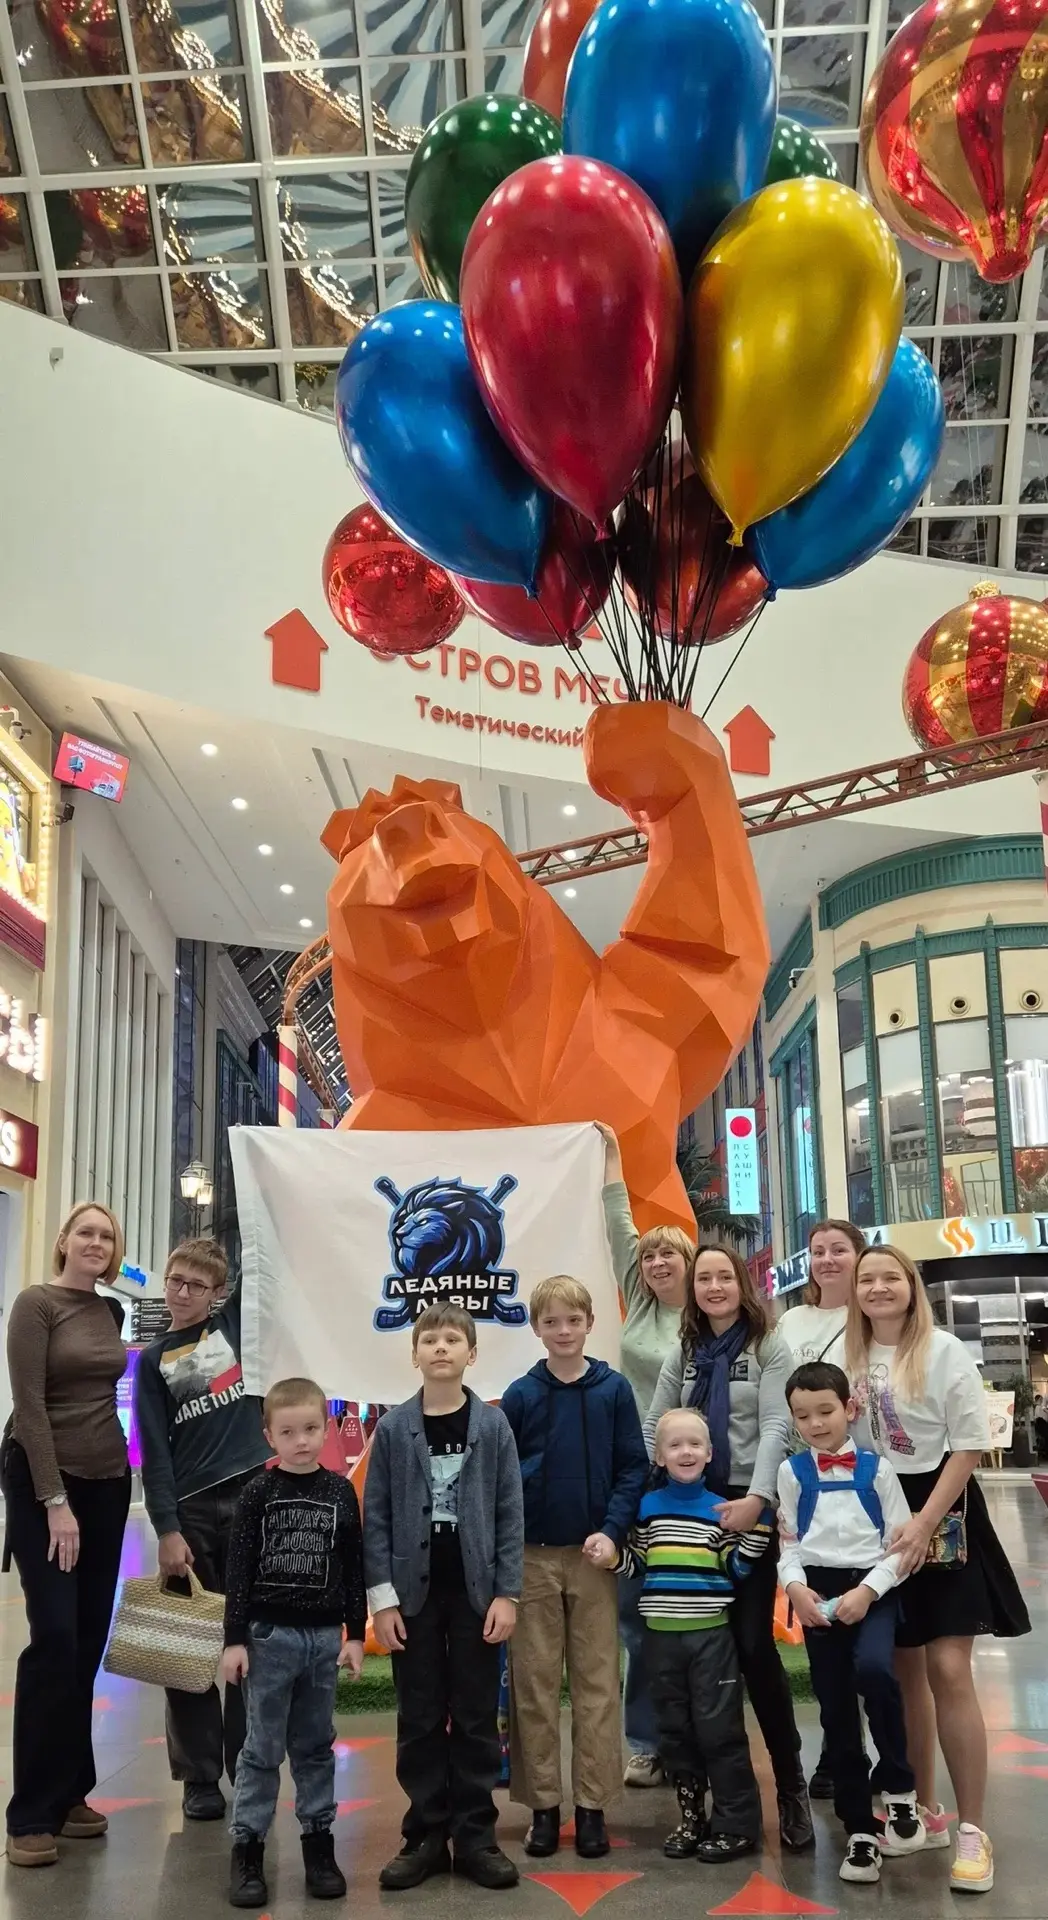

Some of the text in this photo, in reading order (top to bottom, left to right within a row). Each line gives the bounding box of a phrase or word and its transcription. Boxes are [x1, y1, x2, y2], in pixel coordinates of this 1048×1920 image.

[370, 643, 543, 695] СТРОВ
[415, 694, 583, 748] Тематический
[733, 1143, 743, 1207] ПЛАНЕТА
[742, 1143, 752, 1179] СУШИ
[389, 1275, 513, 1295] ЛЕДЯНЫЕ
[268, 1508, 331, 1531] ALWAYS
[269, 1531, 325, 1552] LAUGH
[264, 1552, 325, 1576] LOUDLY
